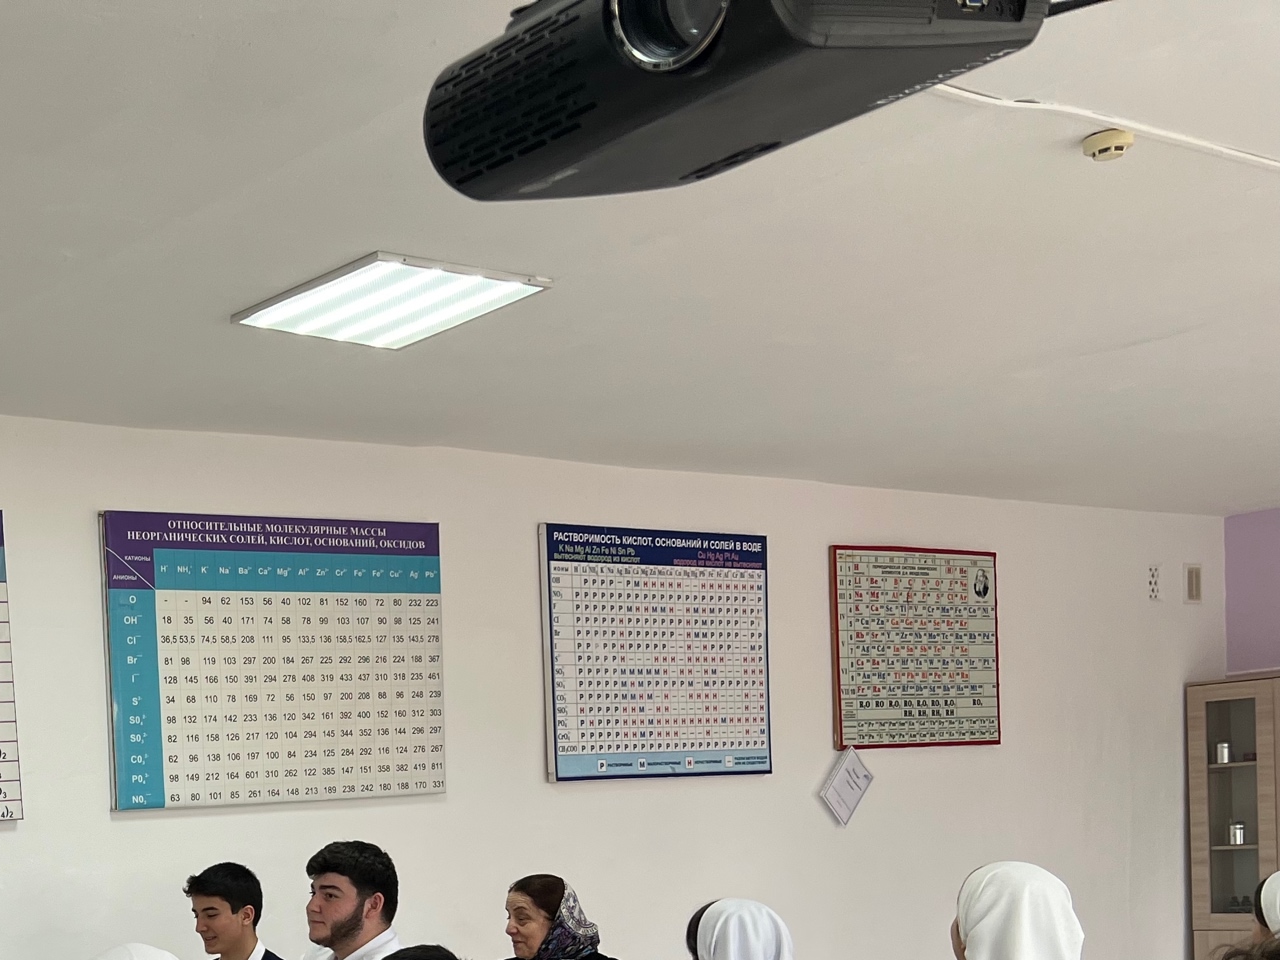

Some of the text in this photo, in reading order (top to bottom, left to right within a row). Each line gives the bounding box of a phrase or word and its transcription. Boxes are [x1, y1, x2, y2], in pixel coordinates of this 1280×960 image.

[168, 520, 387, 537] ОТНОСИТЕЛЬНЫЕ МОЛЕКУЛЯРНЫЕ МАССЫ
[127, 531, 425, 550] НЕОРГАНИЧЕСКИХ СОЛЕЙ, КИСЛОТ, ОСНОВАНИЙ, ОКСИДОВ
[553, 532, 762, 552] РАСТВОРИМОСТЬ КИСЛОТ, ОСНОВАНИЙ И СОЛЕЙ В ВОДЕ
[202, 597, 439, 607] 94 62 153 56 40 102 81 152 160 72 80 232 223
[166, 713, 277, 725] 98 132 174 142 233 136
[170, 787, 299, 802] 63 80 101 85 261 164 148
